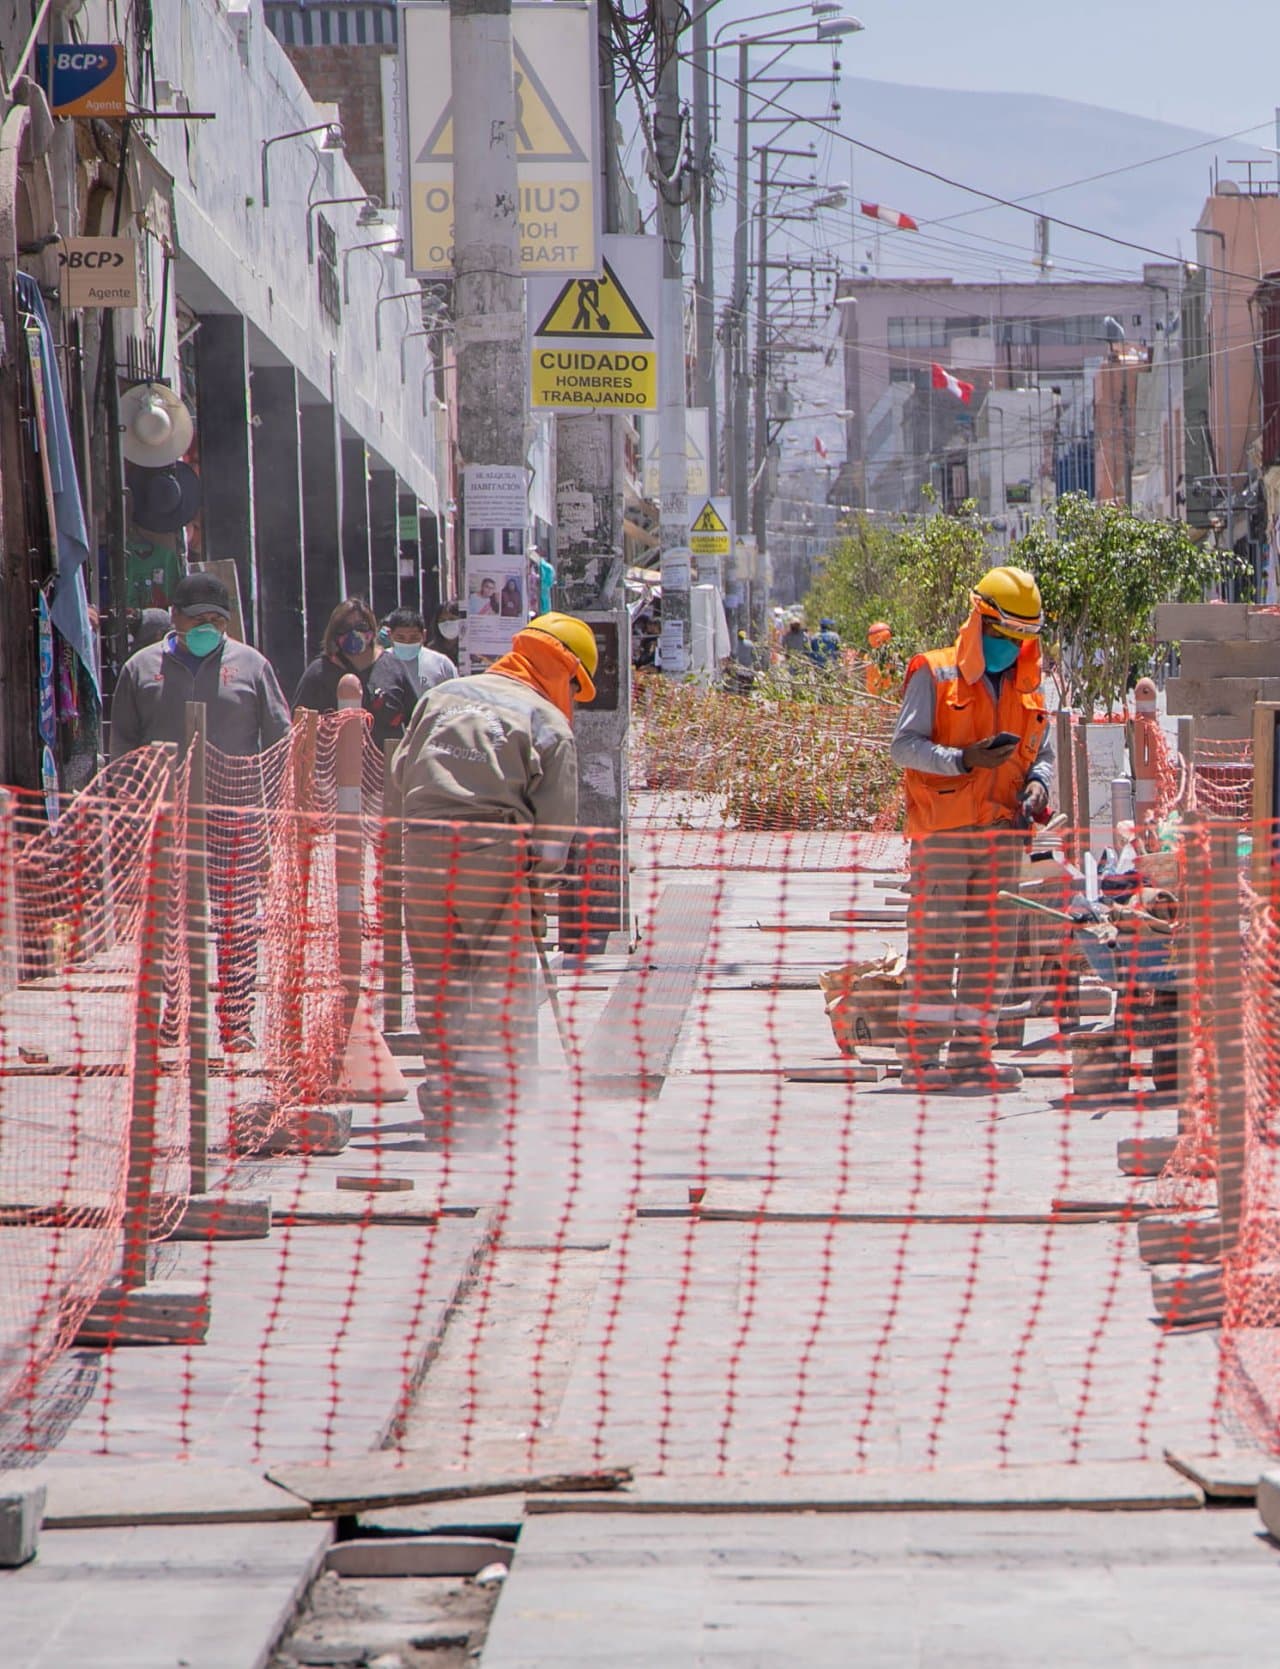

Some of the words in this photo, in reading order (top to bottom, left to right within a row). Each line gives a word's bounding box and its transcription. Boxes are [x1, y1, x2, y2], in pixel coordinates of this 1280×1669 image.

[57, 53, 98, 70] BCP
[85, 101, 122, 110] Agente
[69, 251, 112, 268] BCP
[88, 287, 131, 300] Agente
[540, 352, 649, 372] CUIDADO
[556, 375, 633, 388] HOMBRES
[542, 390, 647, 404] TRABAJANDO
